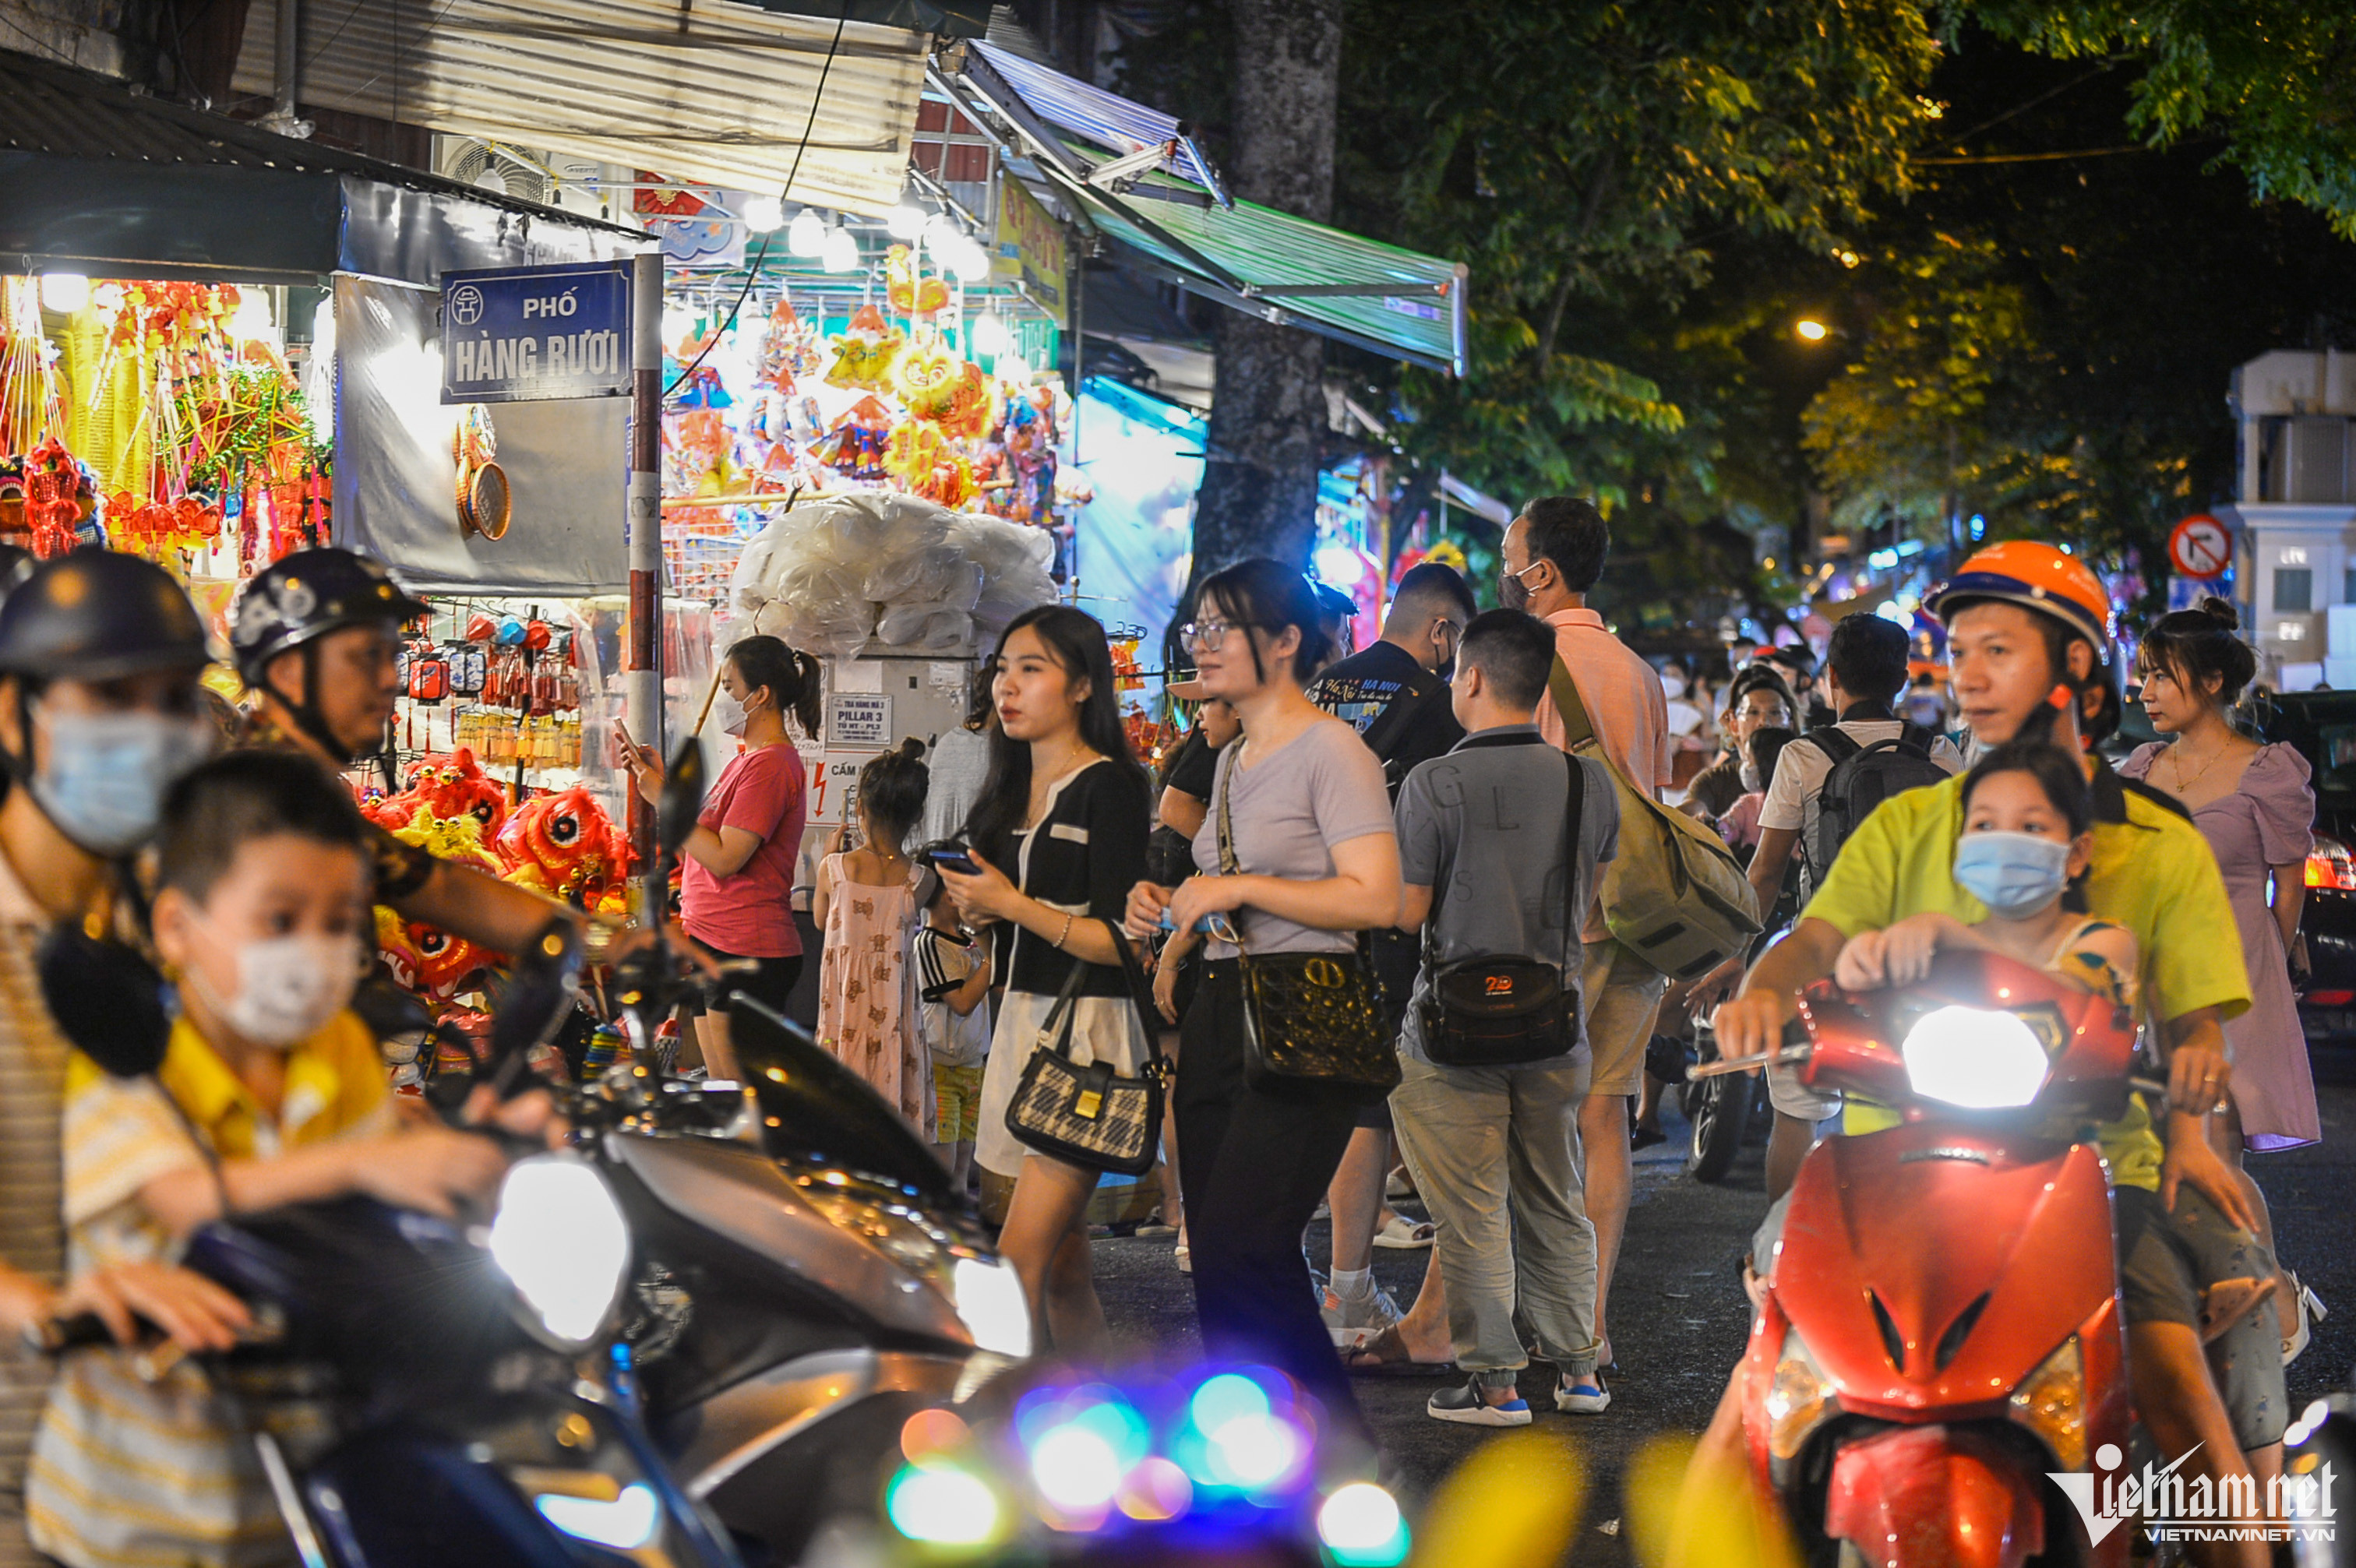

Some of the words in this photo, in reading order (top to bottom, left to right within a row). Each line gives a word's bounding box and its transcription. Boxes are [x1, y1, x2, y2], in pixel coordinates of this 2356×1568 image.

[523, 286, 579, 319] PHỐ
[456, 330, 538, 382] HÀNG
[547, 329, 619, 377] RƯƠI
[1361, 679, 1378, 689] HA
[1378, 681, 1402, 692] NOI
[838, 711, 873, 721] PILLAR
[876, 712, 883, 722] 3
[831, 762, 855, 776] CẤM
